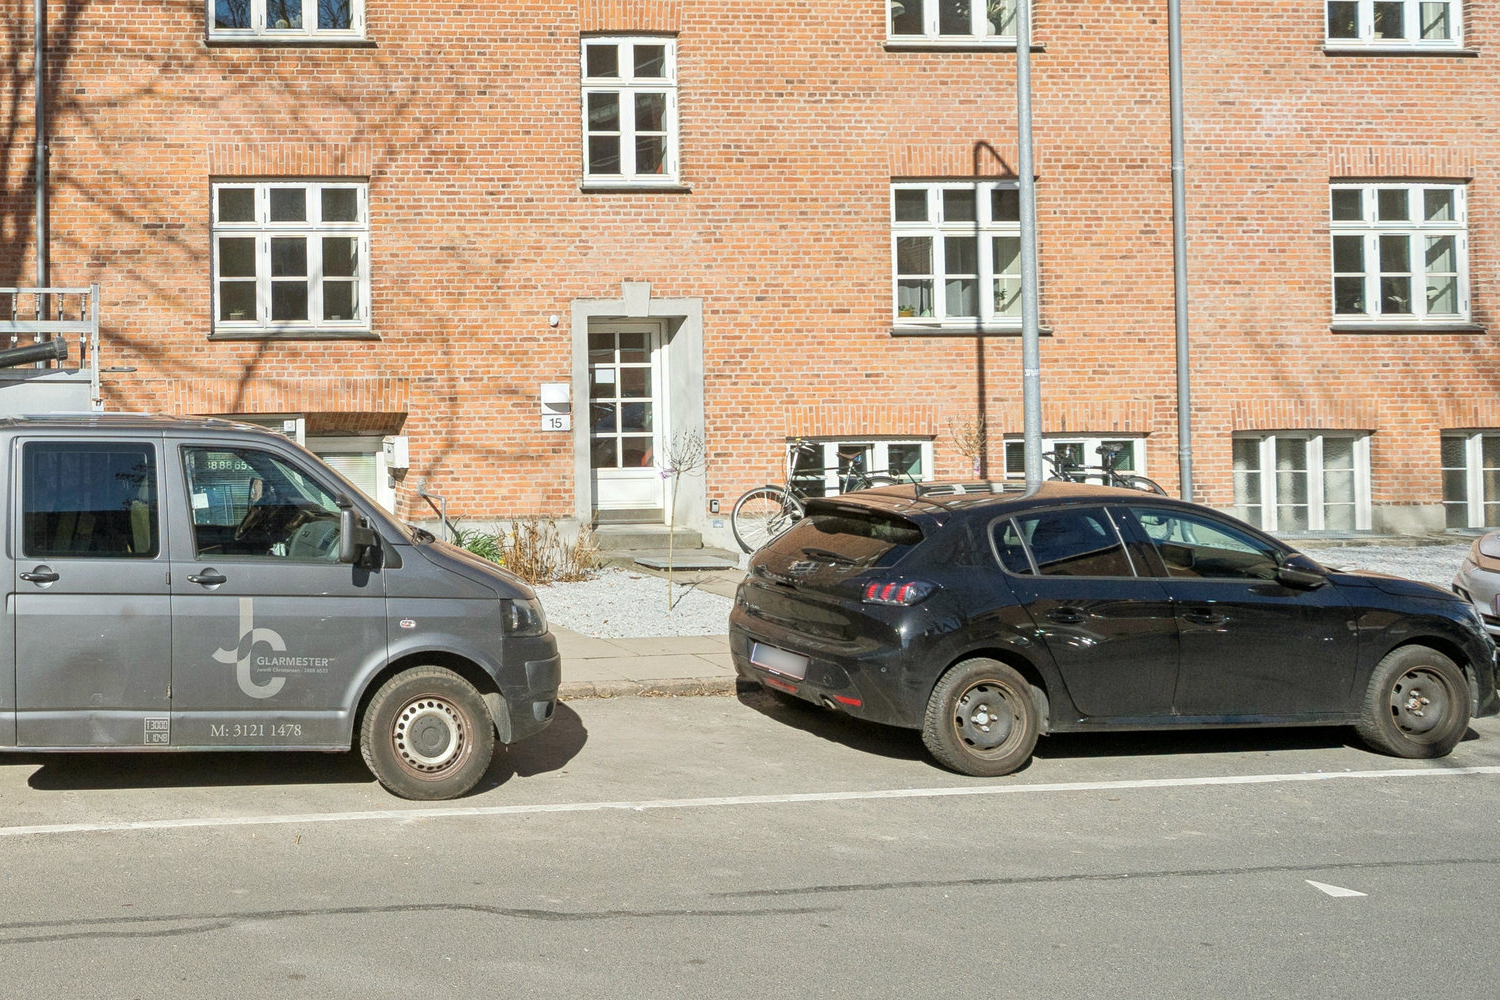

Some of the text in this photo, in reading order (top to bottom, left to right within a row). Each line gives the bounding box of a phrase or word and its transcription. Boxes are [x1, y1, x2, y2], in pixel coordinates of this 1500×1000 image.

[549, 418, 562, 428] 15
[256, 656, 329, 667] GLARMESTER
[210, 724, 302, 737] M: 3121 1478
